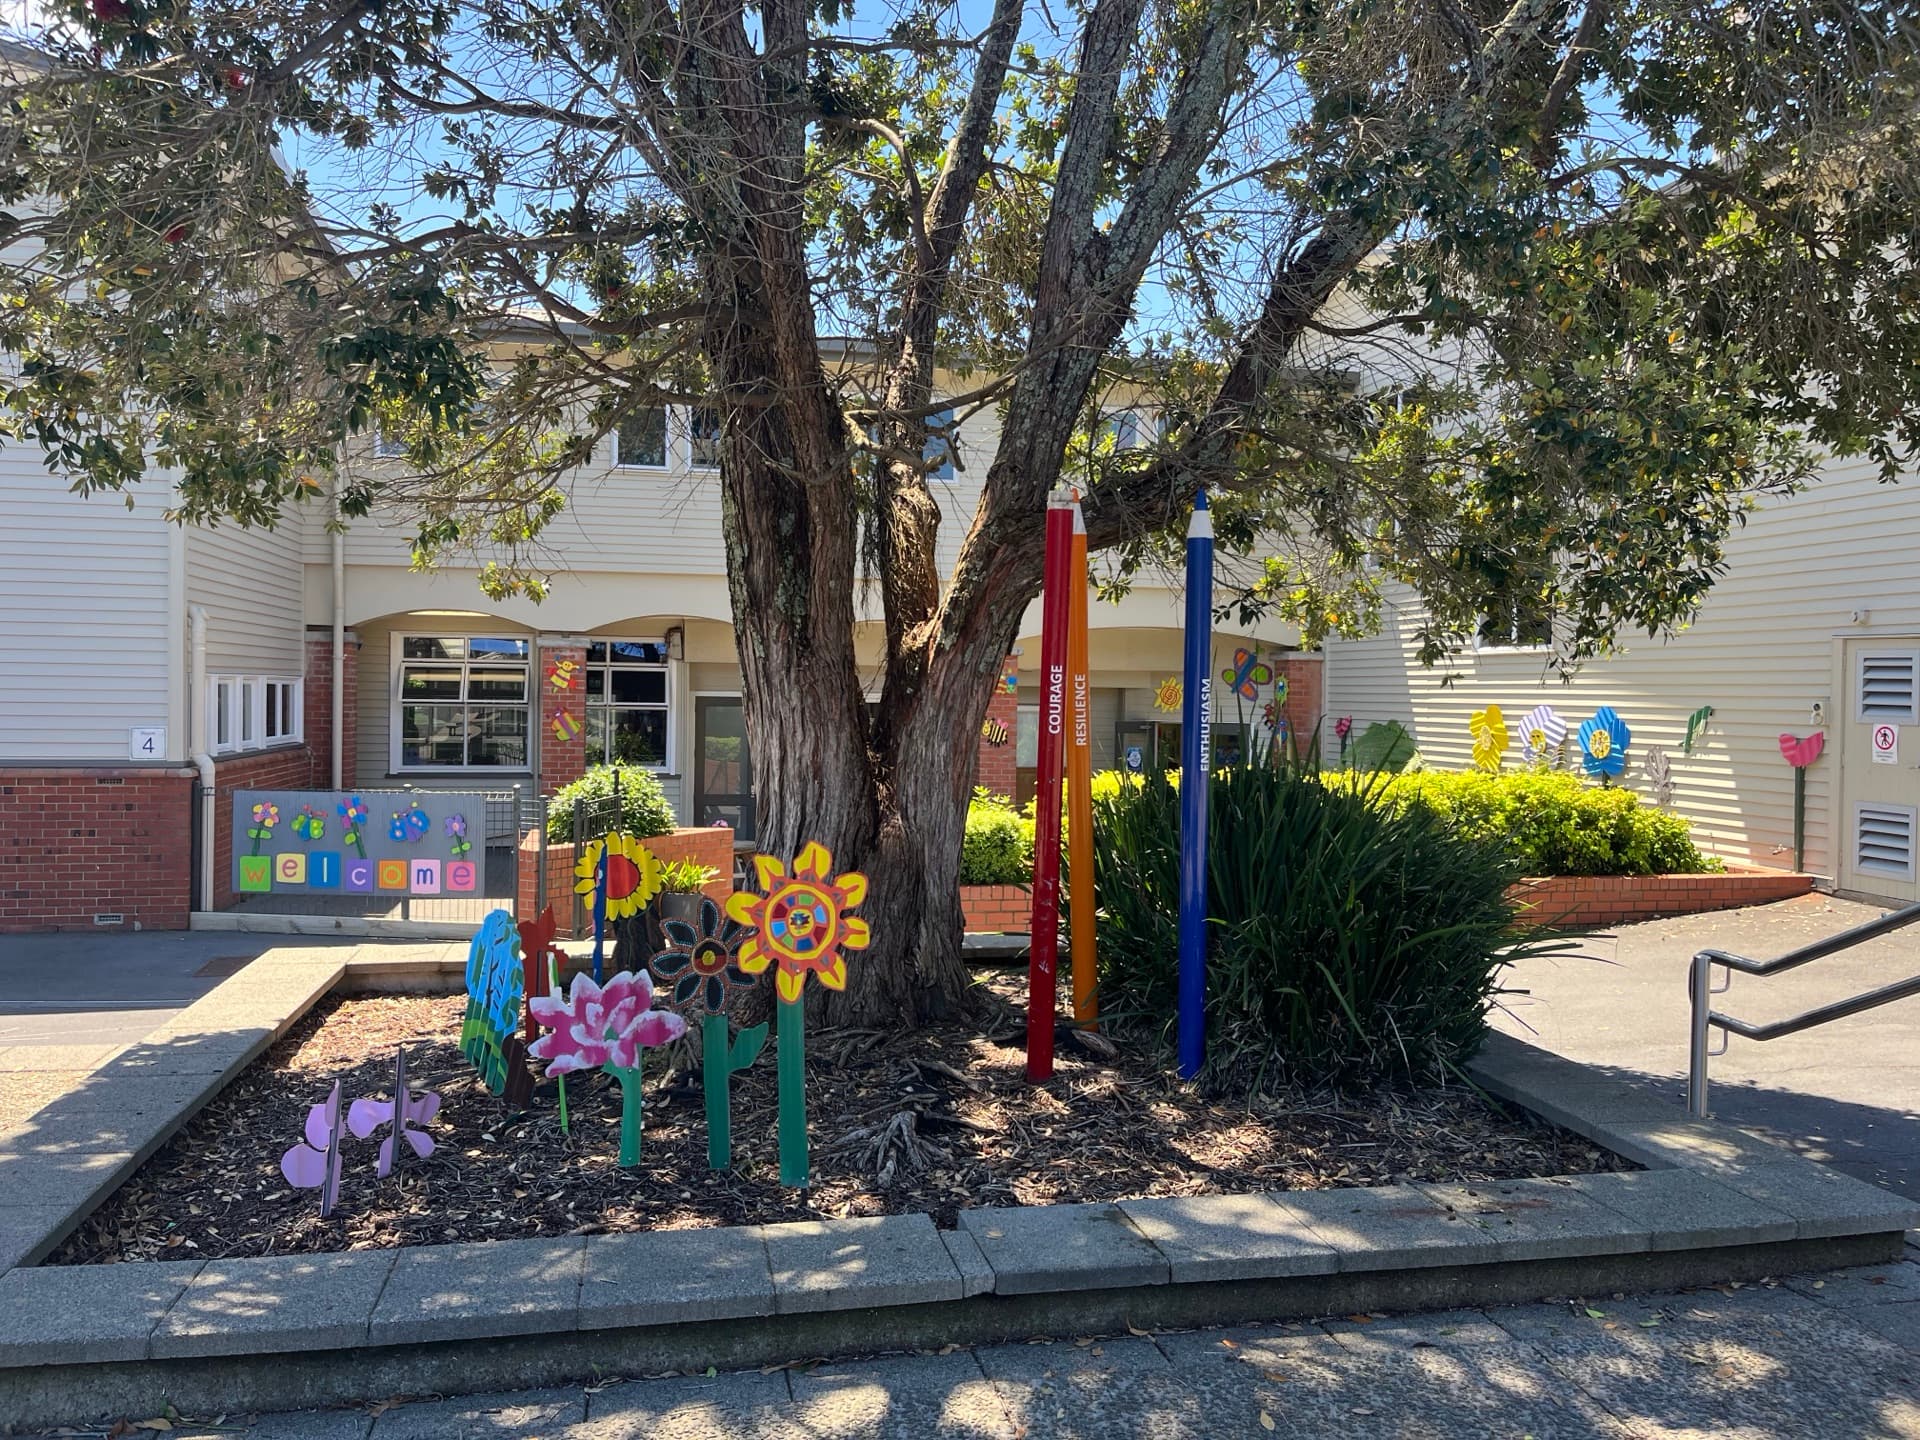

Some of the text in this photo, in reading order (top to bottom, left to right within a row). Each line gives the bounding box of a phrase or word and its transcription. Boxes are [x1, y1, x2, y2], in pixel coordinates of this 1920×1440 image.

[1048, 664, 1063, 734] COURAGE
[1074, 673, 1087, 746] RESILIENCE
[1200, 678, 1211, 772] ENTHUSIASM
[142, 736, 155, 753] 4
[243, 856, 472, 887] welcome
